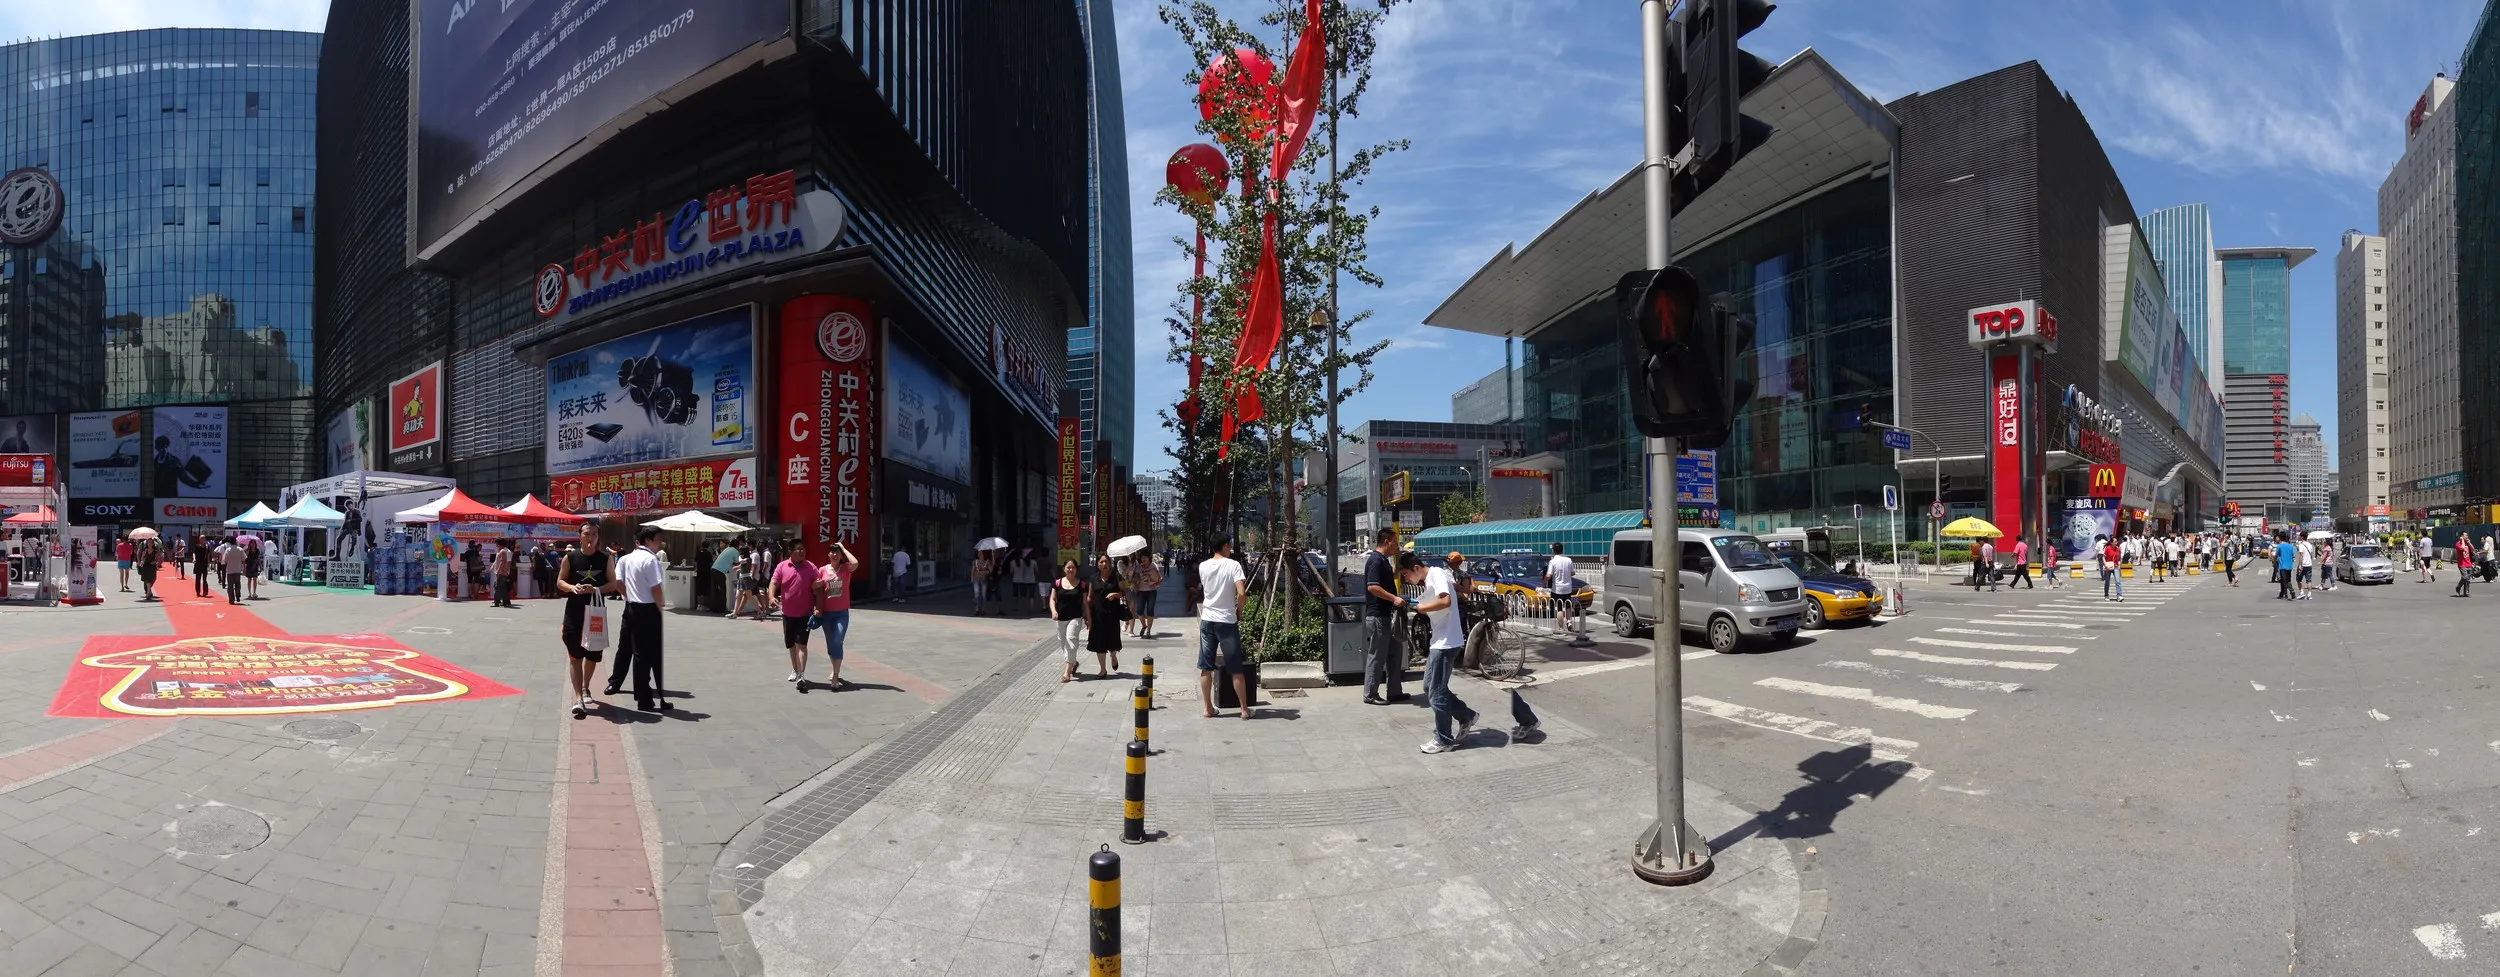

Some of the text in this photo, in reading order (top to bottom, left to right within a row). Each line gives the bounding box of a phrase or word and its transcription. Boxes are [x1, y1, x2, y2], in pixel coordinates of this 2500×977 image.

[573, 169, 796, 289] 中关村e世界
[1973, 307, 2024, 335] TOP
[552, 355, 590, 386] ThinkPad
[558, 391, 607, 421] 探未来
[1999, 379, 2018, 419] 鼎好
[402, 416, 424, 435] 真功夫
[819, 370, 832, 482] ZHONGGUANCUN
[2, 458, 29, 469] FUJITSU
[837, 371, 859, 544] 中关村e世界
[728, 469, 749, 490] 7月
[1061, 423, 1076, 529] e世界店庆五周年
[85, 505, 136, 515] SONY
[163, 504, 217, 517] Canon
[2066, 498, 2092, 509] 麦旋风
